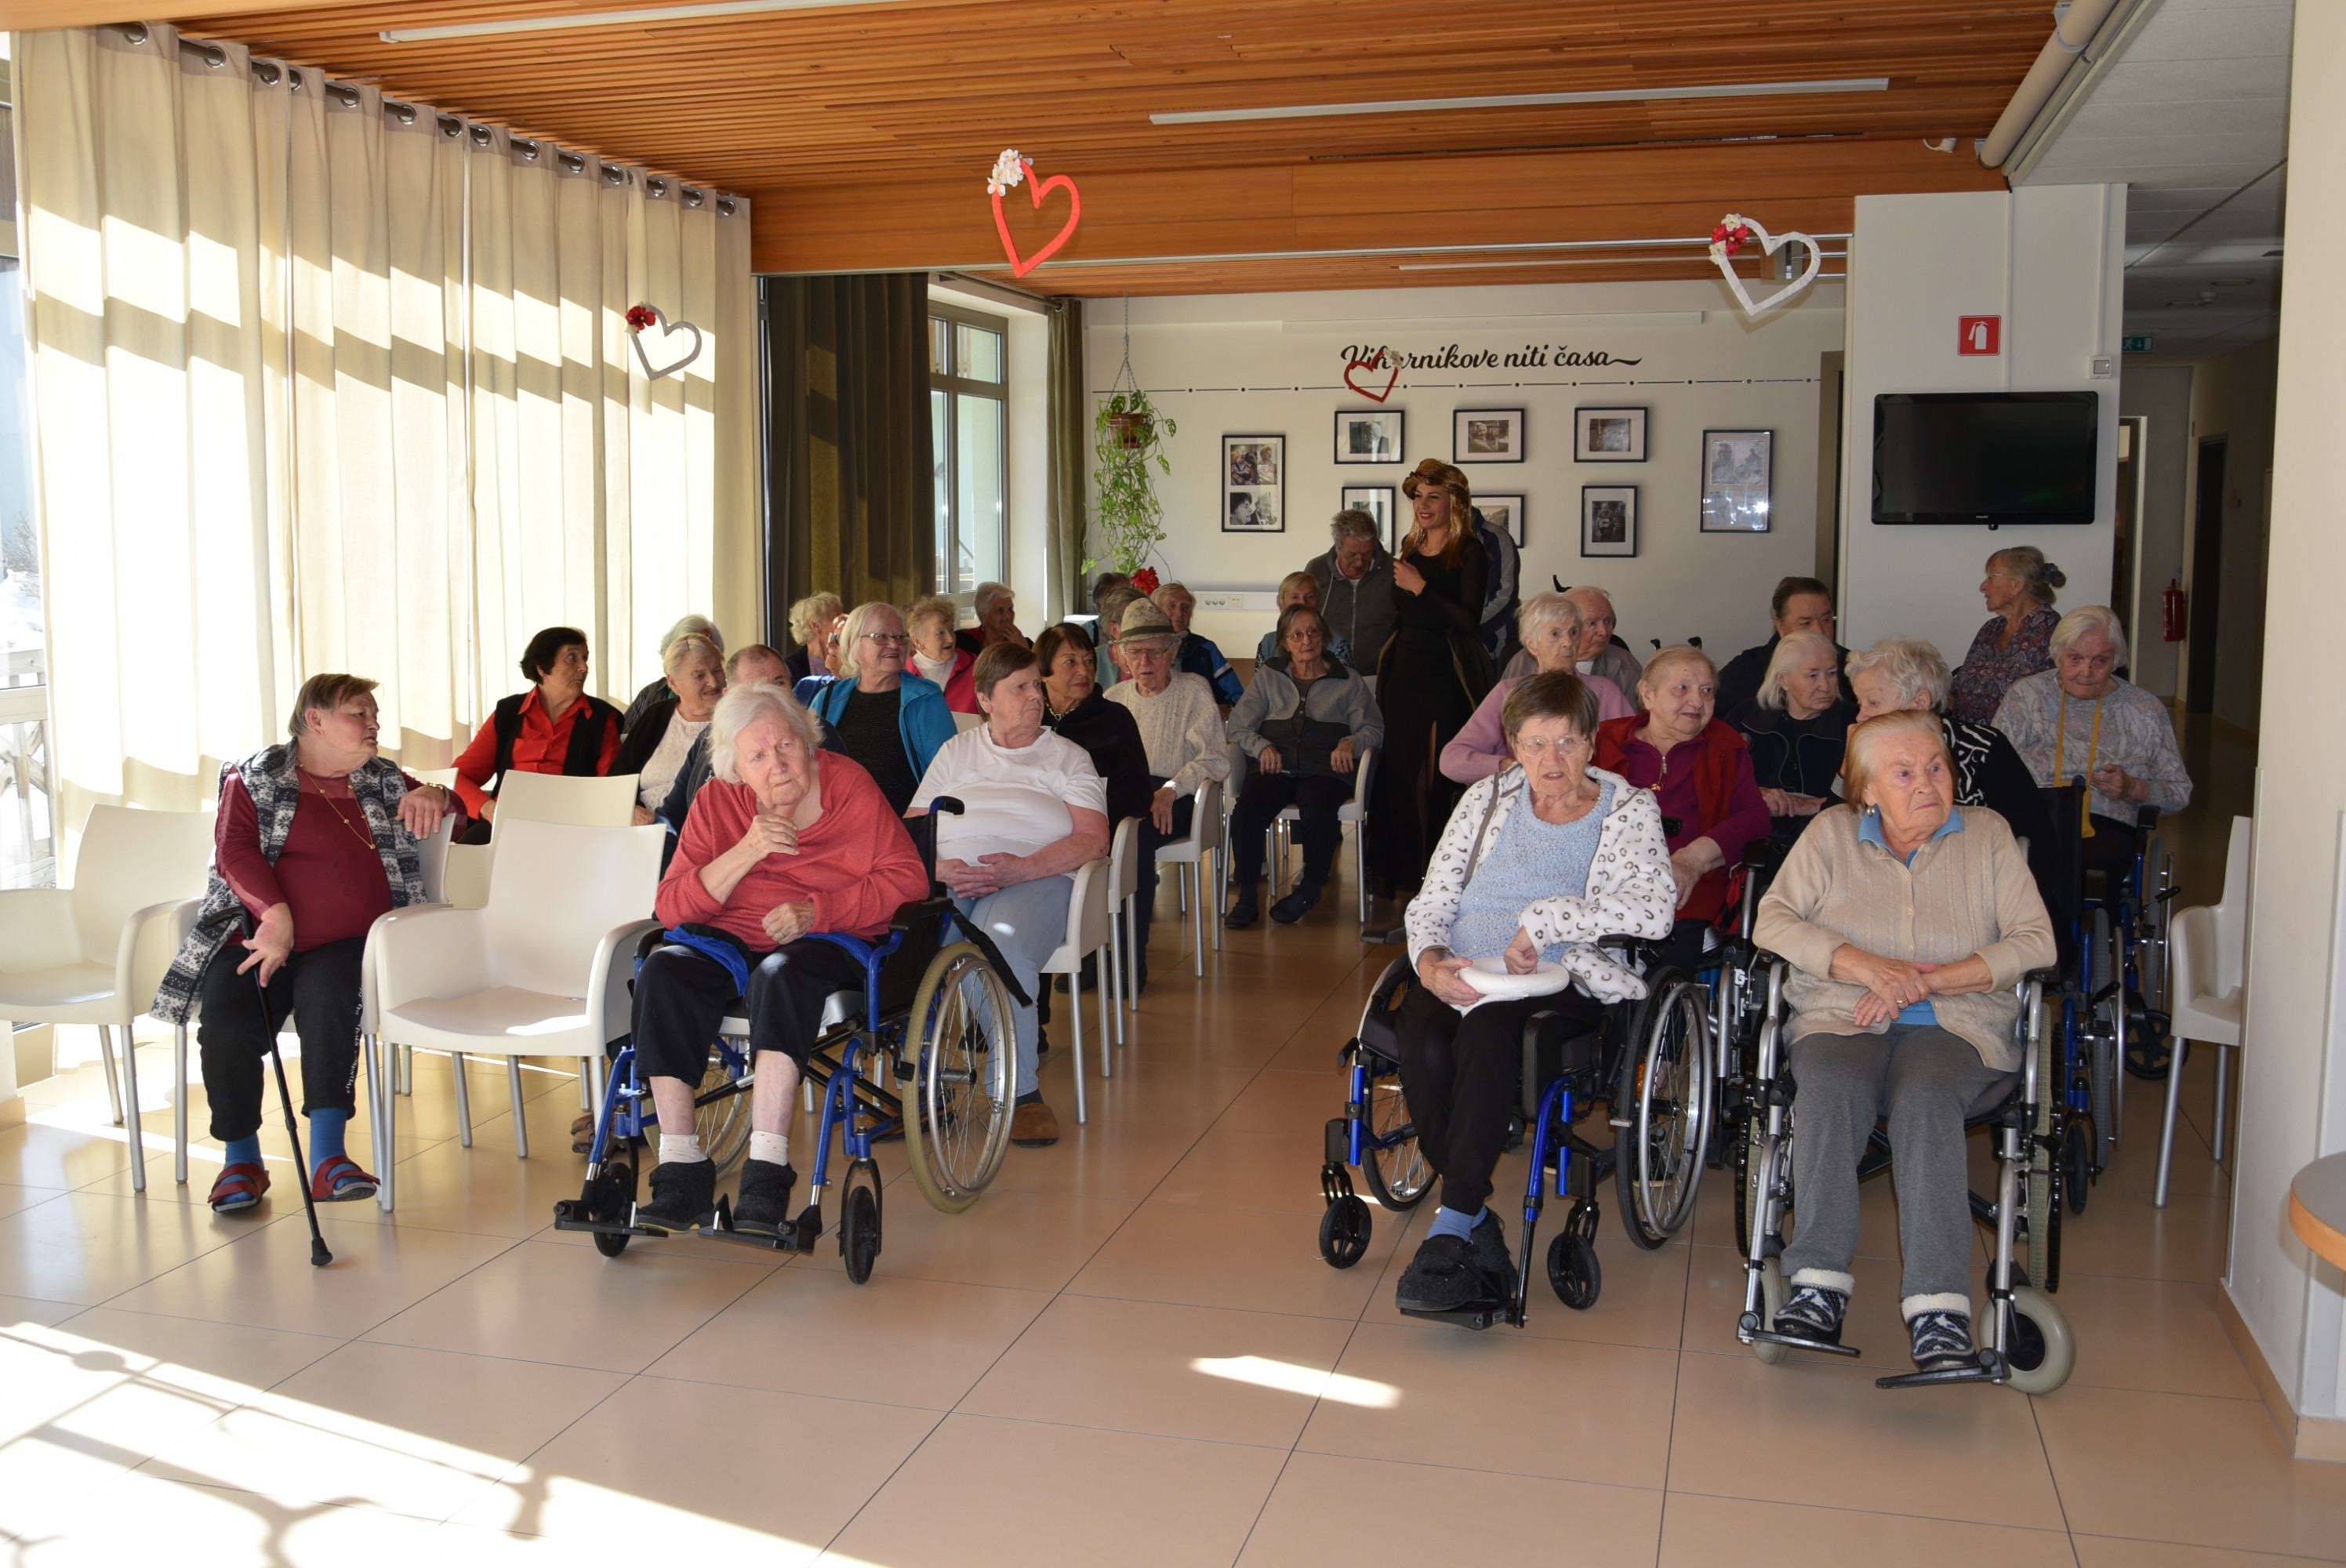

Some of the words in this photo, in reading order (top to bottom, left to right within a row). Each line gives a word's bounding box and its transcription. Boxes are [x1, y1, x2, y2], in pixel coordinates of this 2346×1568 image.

[1340, 343, 1499, 370] Vihrnikove
[1503, 343, 1549, 368] niti
[1553, 344, 1643, 367] časa
